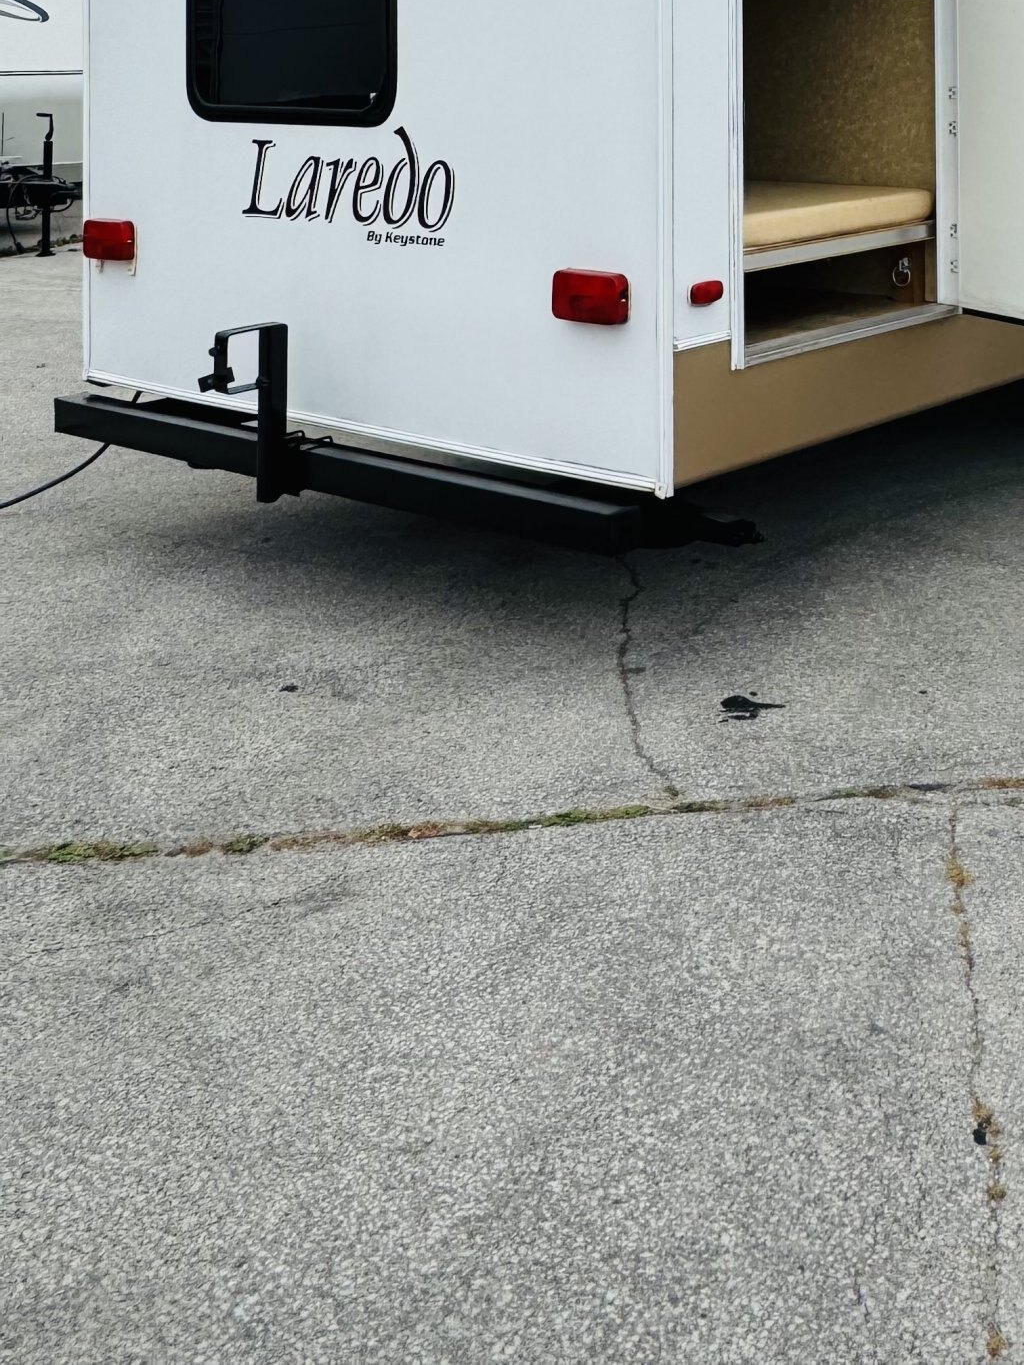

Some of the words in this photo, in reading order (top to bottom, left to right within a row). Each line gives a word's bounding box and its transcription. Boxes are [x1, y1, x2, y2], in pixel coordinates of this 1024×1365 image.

[242, 126, 455, 232] Laredo
[366, 230, 382, 245] By
[384, 231, 445, 247] Keystone
